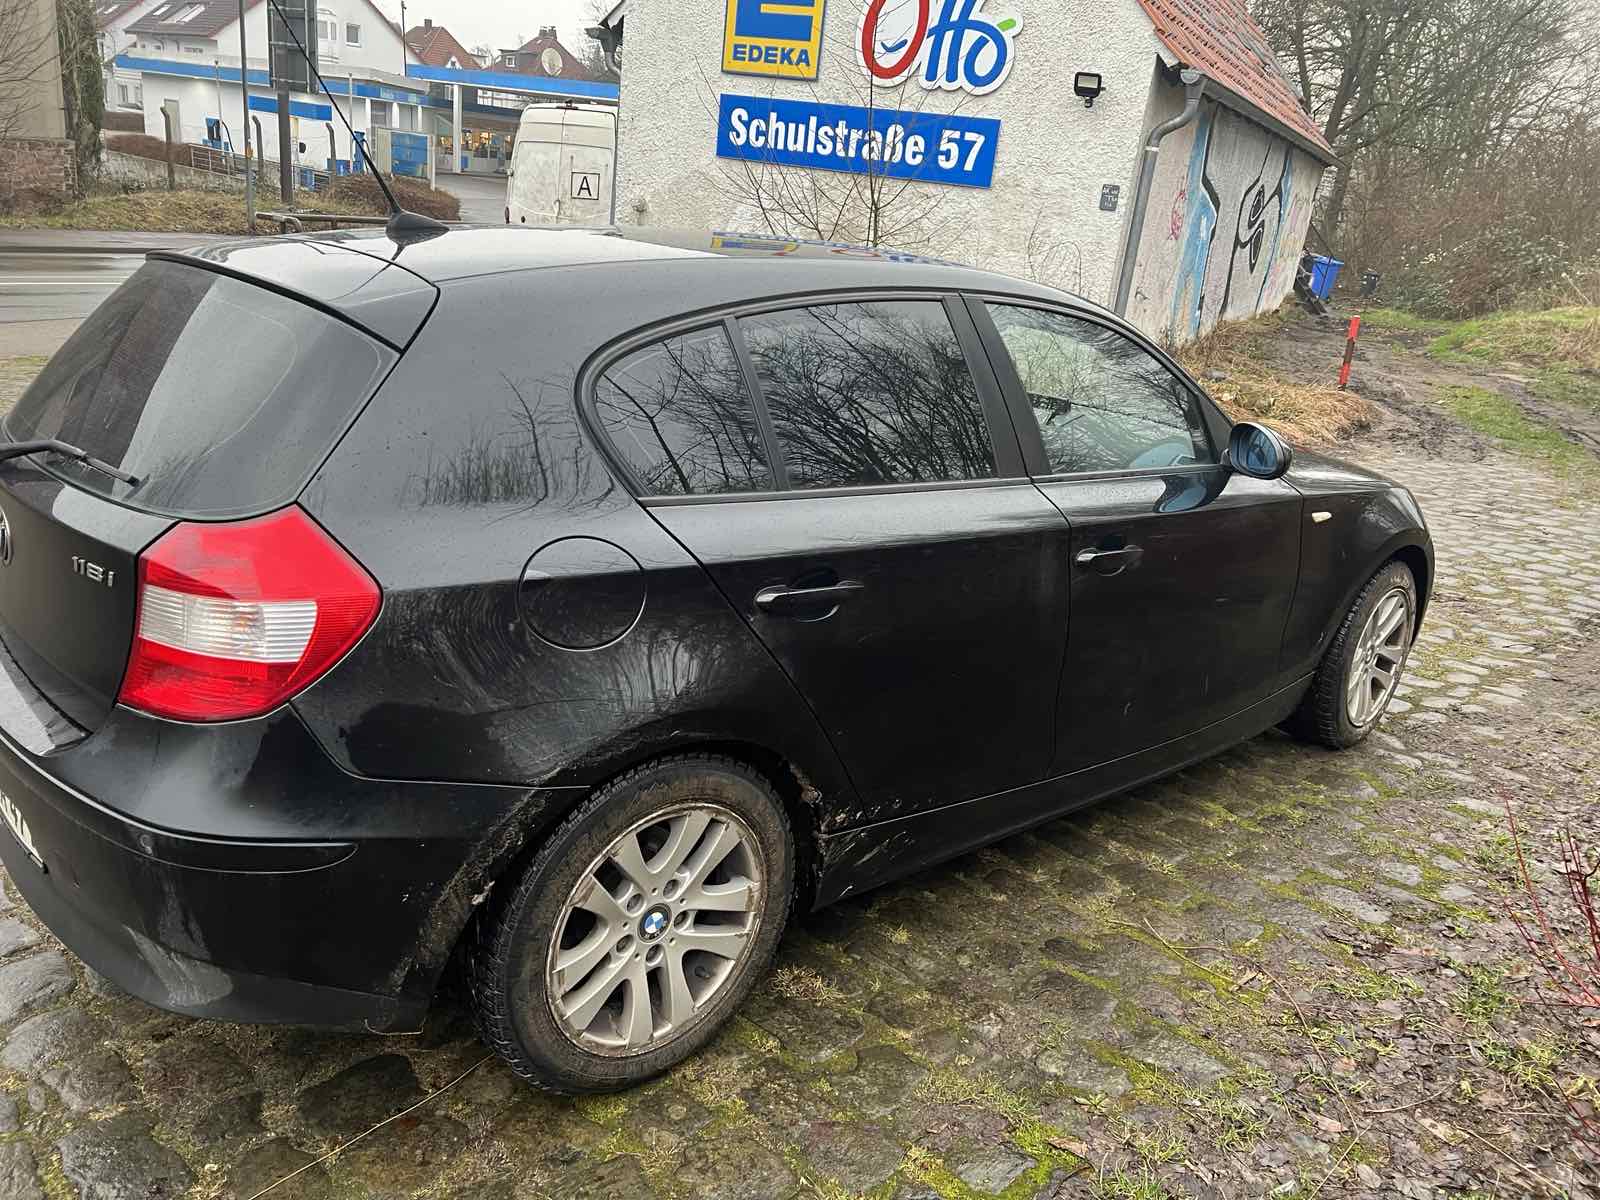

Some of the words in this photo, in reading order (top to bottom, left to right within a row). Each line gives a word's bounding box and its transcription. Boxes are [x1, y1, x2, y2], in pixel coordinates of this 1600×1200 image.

[732, 44, 810, 67] EDEKA
[729, 107, 925, 164] Schulstraße
[937, 130, 985, 171] 57
[577, 175, 592, 197] A
